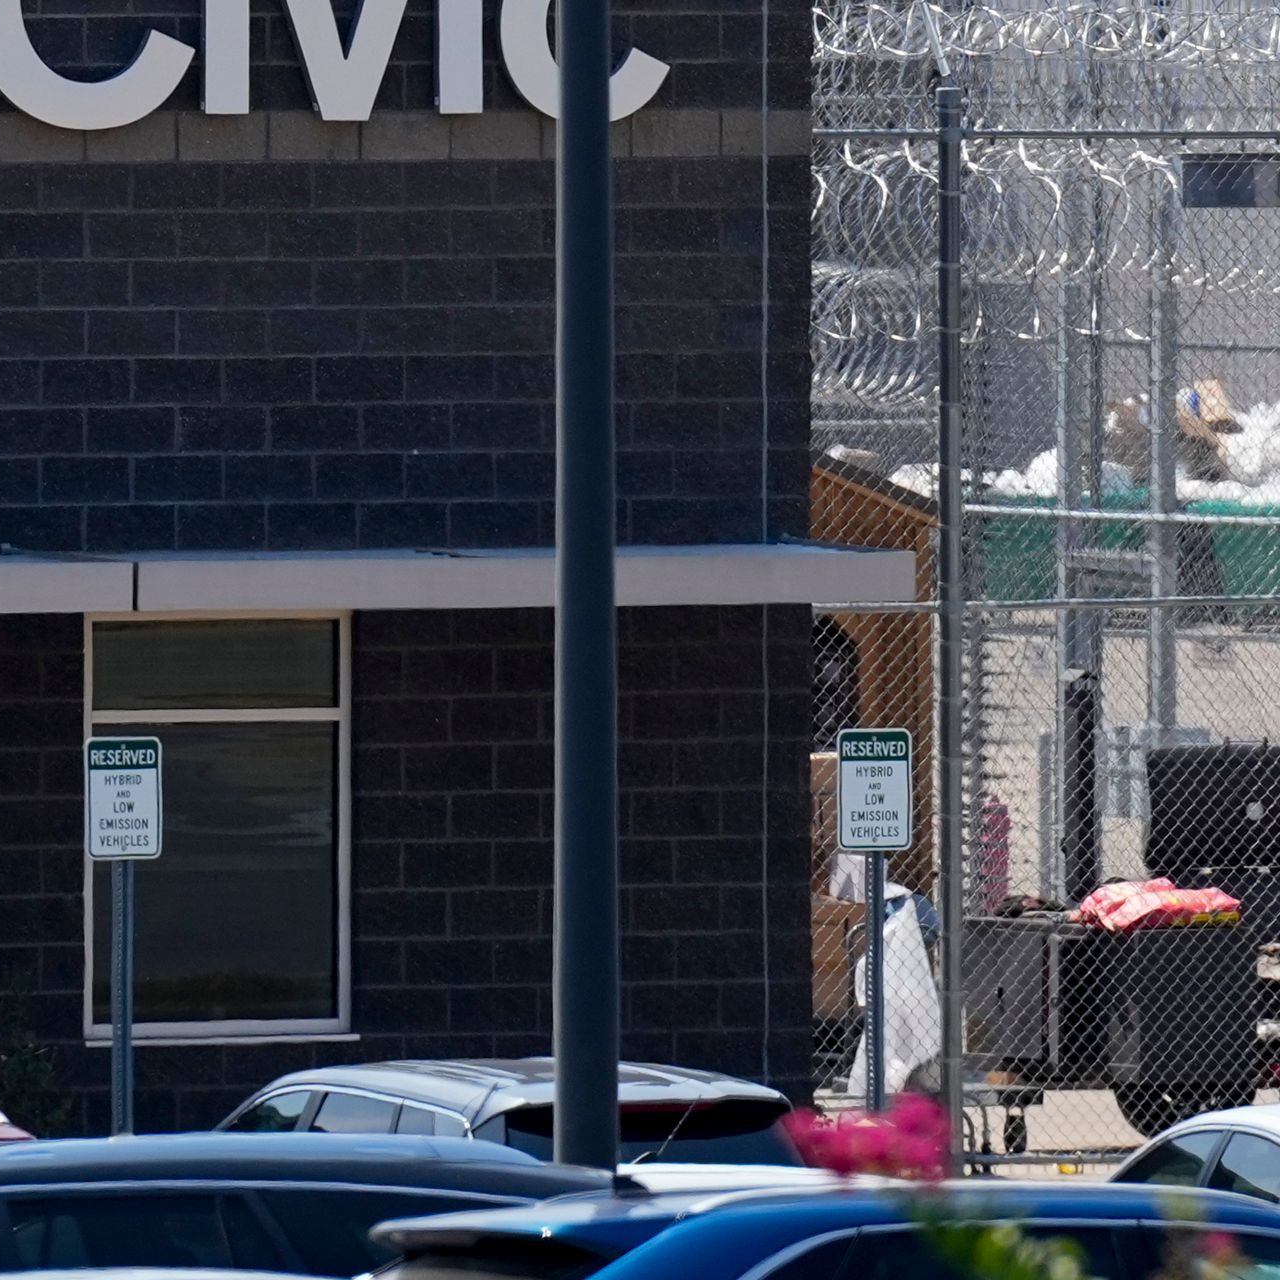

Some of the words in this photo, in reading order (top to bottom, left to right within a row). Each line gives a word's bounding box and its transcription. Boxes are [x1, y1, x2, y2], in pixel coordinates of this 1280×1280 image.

[842, 740, 906, 758] RESERVED
[90, 748, 156, 766] RESERVED
[855, 766, 893, 778] HYBRID
[104, 774, 142, 786] HYBRID
[868, 782, 882, 790] AND
[116, 790, 131, 798] AND
[864, 794, 885, 806] LOW
[113, 802, 135, 813] LOW
[850, 810, 899, 822] EMISSION
[99, 818, 149, 830] EMISSION
[850, 826, 900, 838] VEHICLES
[99, 835, 149, 847] VEHICLES
